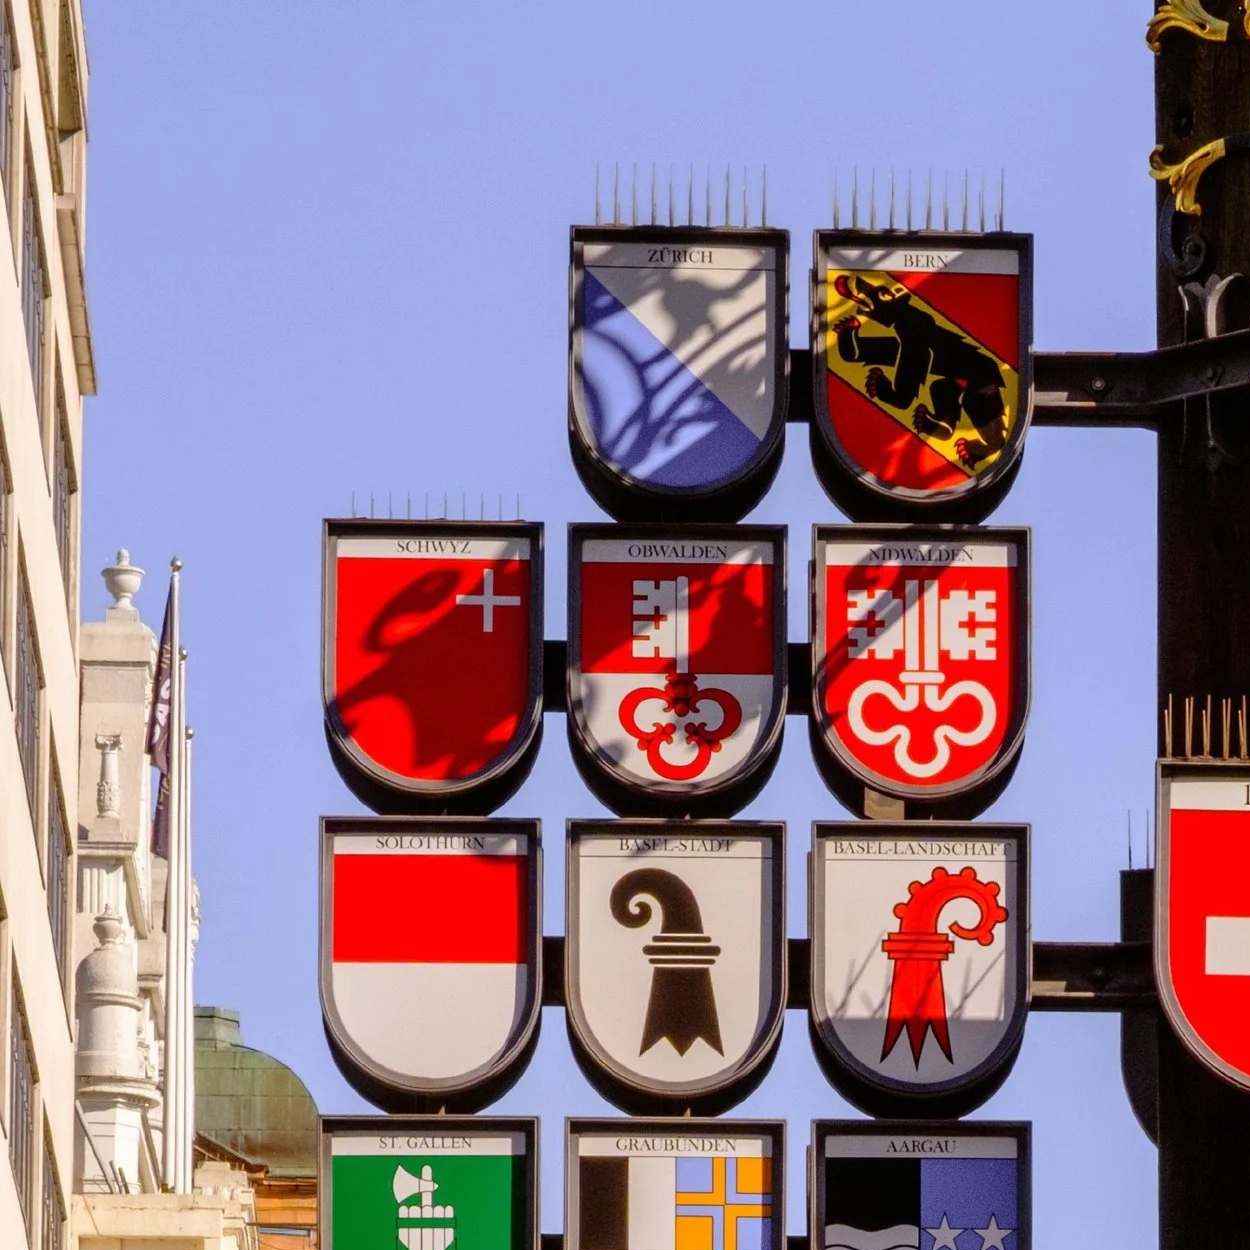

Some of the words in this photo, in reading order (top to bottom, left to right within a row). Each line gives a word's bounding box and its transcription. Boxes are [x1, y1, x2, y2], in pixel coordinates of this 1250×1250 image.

[648, 247, 713, 264] ZÜRICH
[904, 254, 948, 268] BERN
[396, 540, 471, 554] SCHWYZ
[628, 543, 727, 559] OBWALDEN
[869, 547, 973, 563] NIDWALDEN
[376, 834, 485, 850] SOLOTHURN
[619, 838, 733, 852] BASEL-STADT
[834, 841, 1011, 856] BASEL-LANDSCHAFT
[379, 1136, 402, 1149] ST.
[407, 1136, 472, 1149] GALLEN
[886, 1140, 957, 1153] AARGAU
